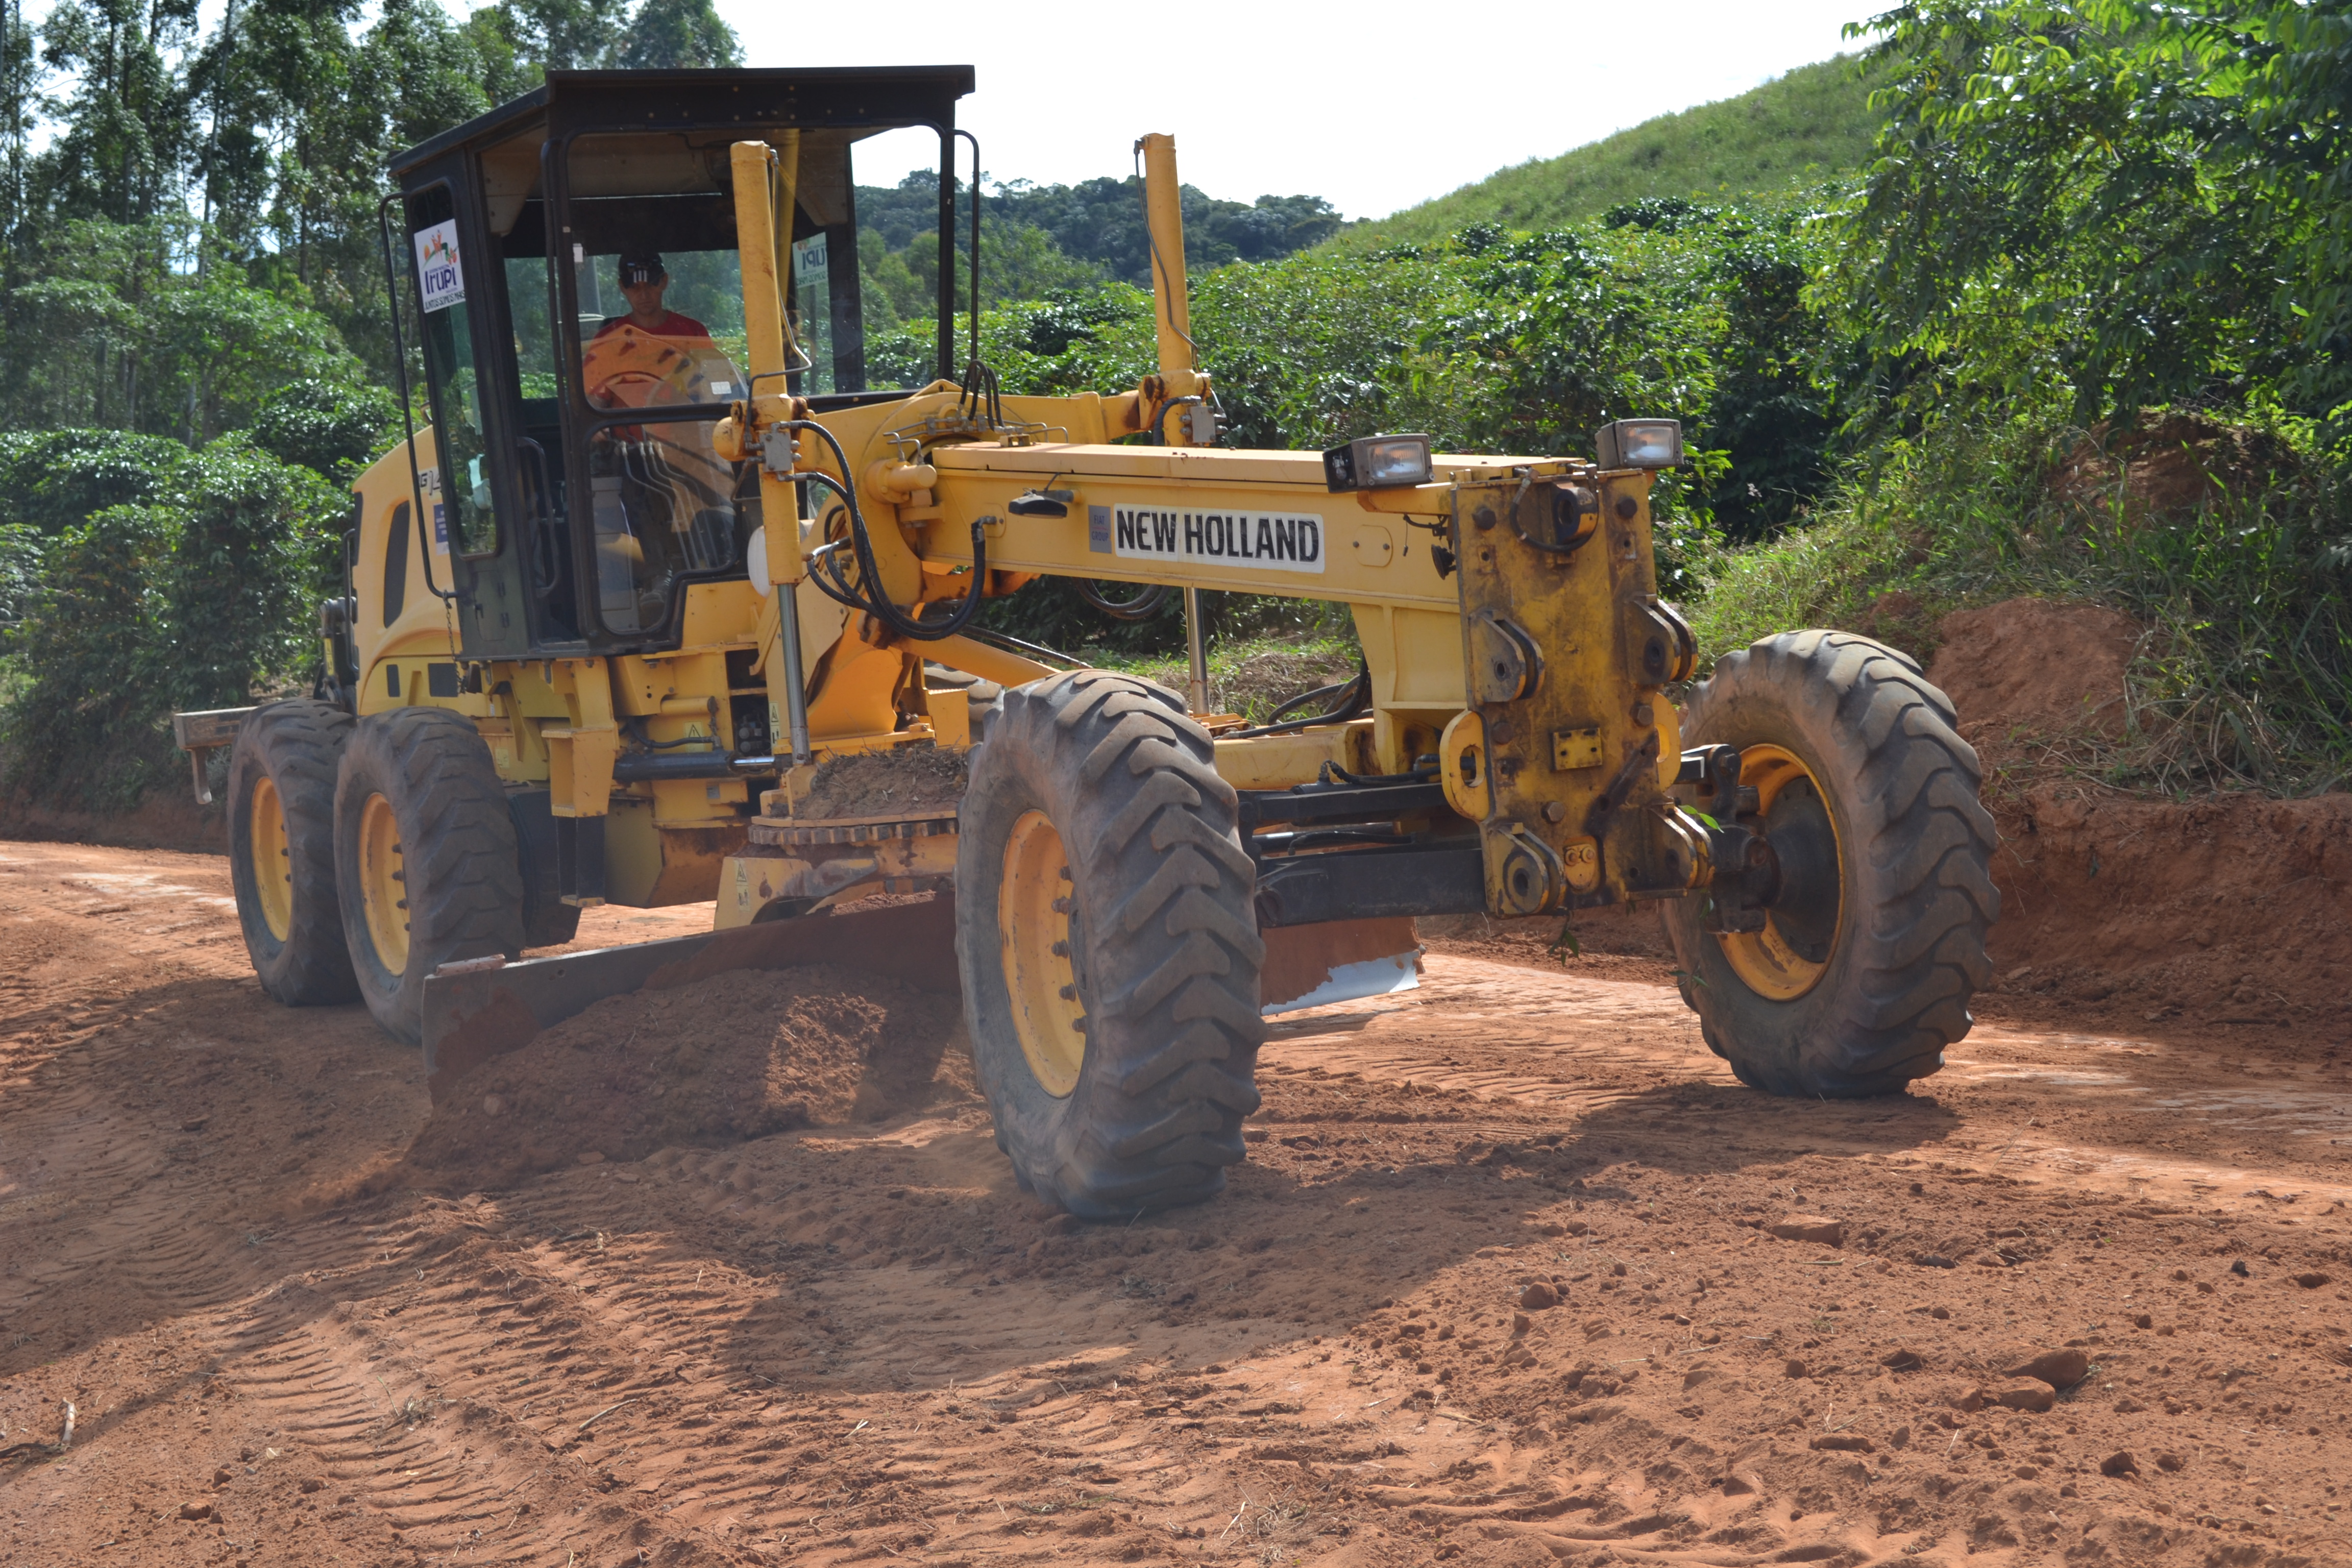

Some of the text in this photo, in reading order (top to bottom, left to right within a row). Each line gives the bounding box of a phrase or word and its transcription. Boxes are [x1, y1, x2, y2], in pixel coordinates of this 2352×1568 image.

[1094, 514, 1105, 525] FIAT
[1092, 531, 1109, 542] GROUP
[1117, 508, 1319, 562] NEW HOLLAND
